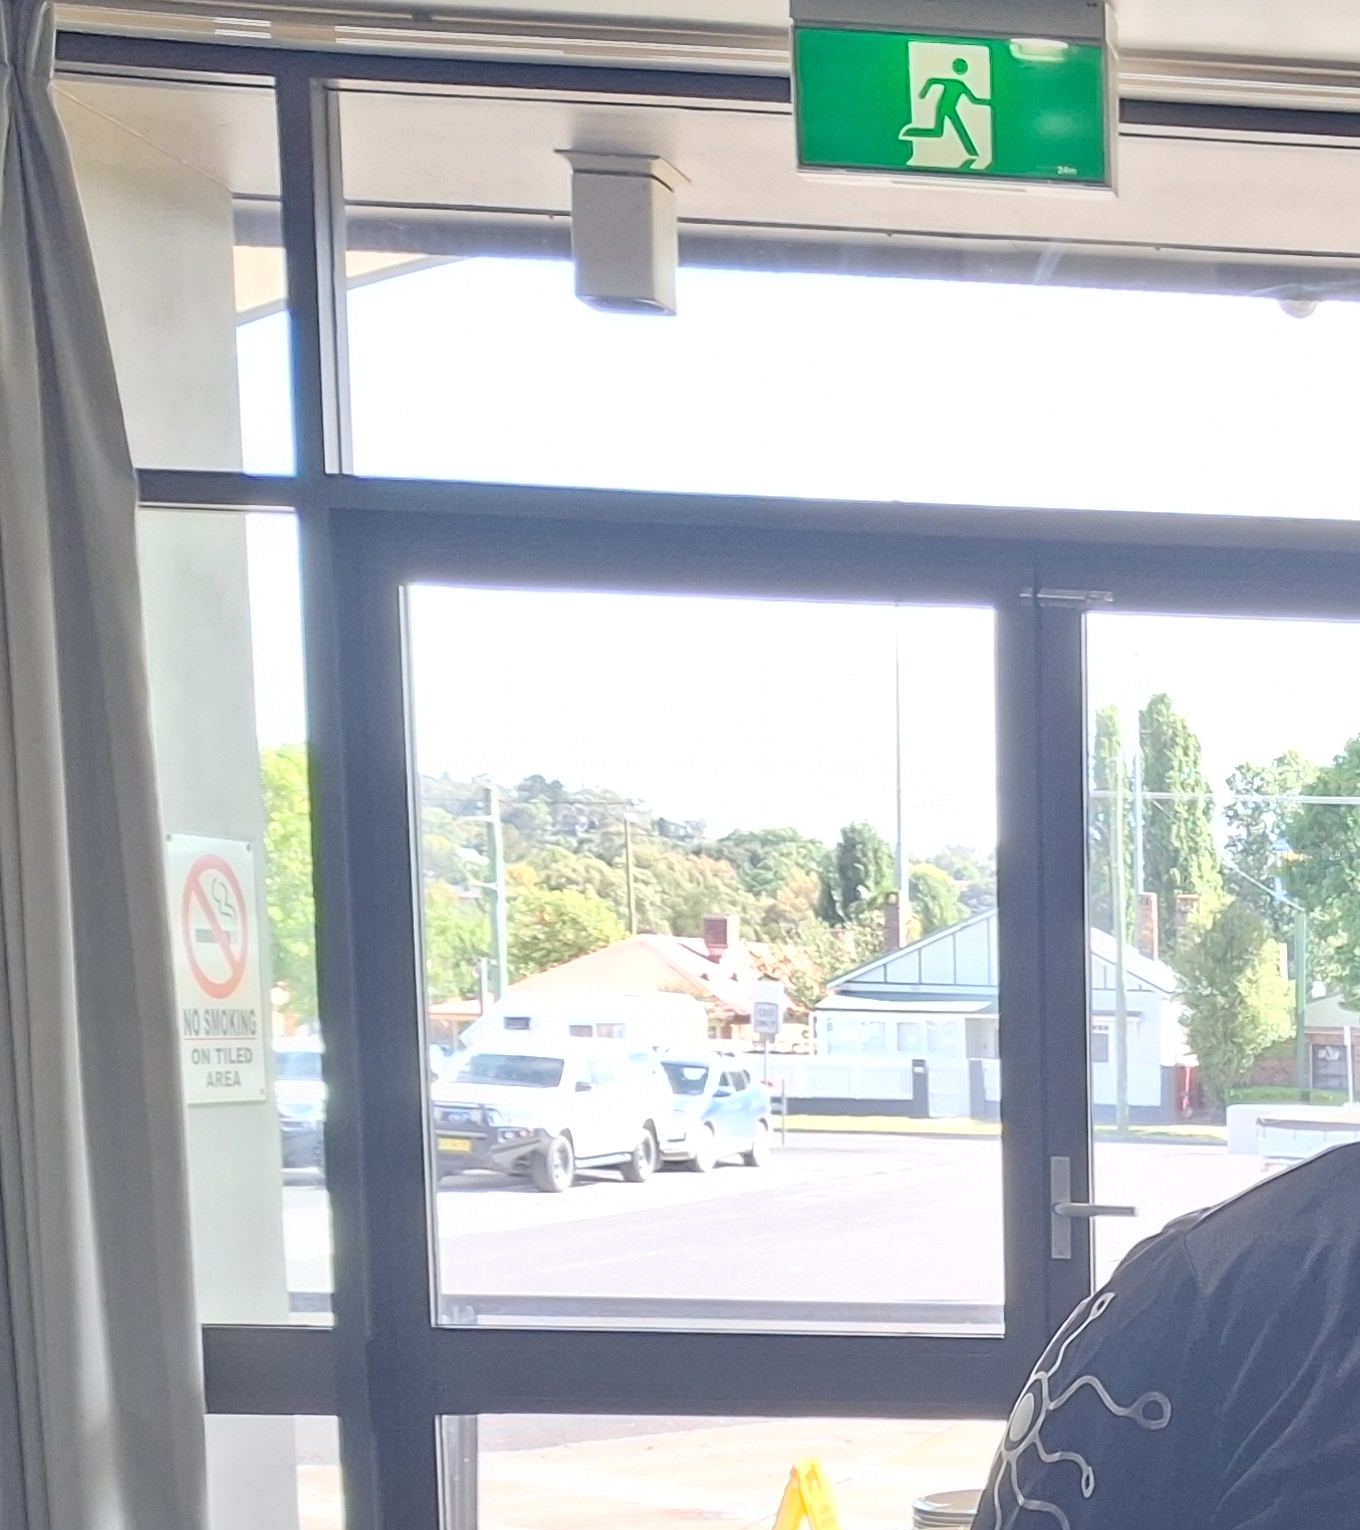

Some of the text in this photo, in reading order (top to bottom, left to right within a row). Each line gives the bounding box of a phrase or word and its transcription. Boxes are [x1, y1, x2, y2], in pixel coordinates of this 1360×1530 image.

[183, 1008, 256, 1036] NO SMOKING
[191, 1047, 253, 1065] ON TILED
[206, 1070, 242, 1088] AREA
